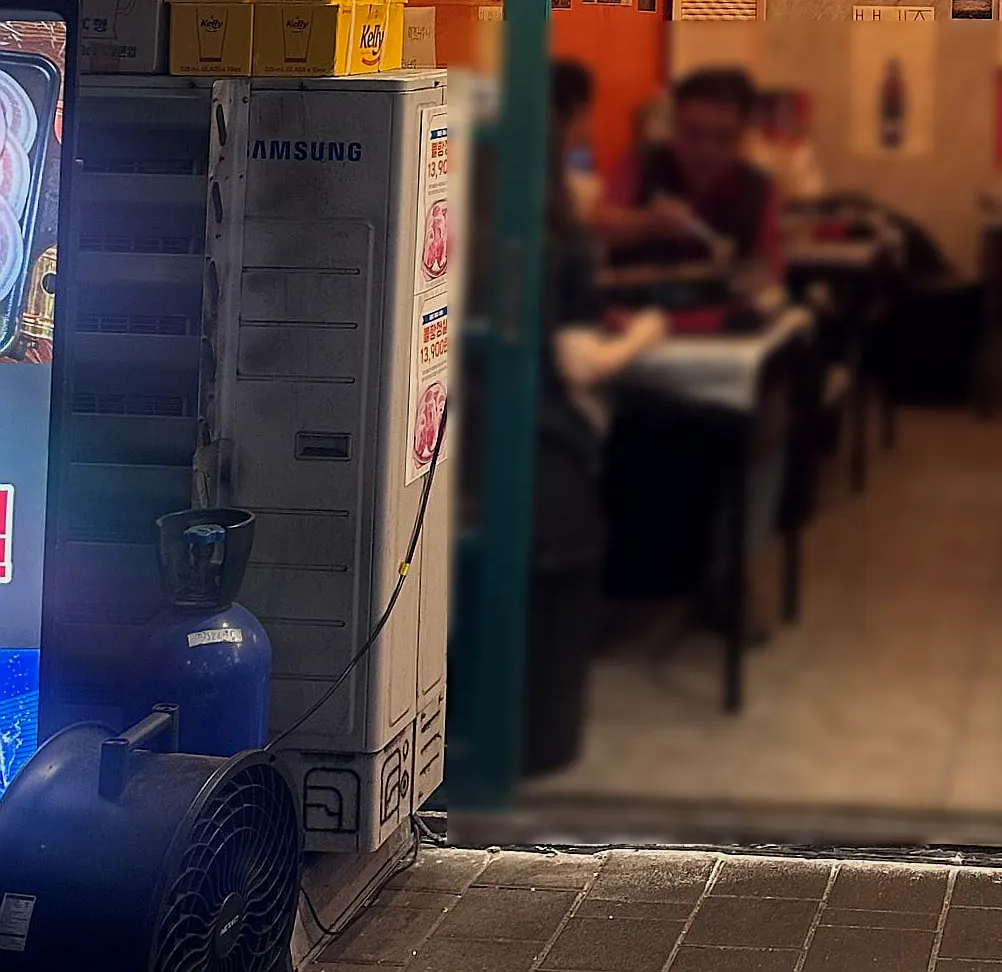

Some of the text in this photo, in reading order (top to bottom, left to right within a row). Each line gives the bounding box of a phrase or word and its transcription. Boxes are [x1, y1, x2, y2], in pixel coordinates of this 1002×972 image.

[200, 19, 224, 30] Kelly
[285, 19, 309, 30] Kelly
[359, 25, 385, 57] Kelly
[247, 140, 362, 162] AMSUNG
